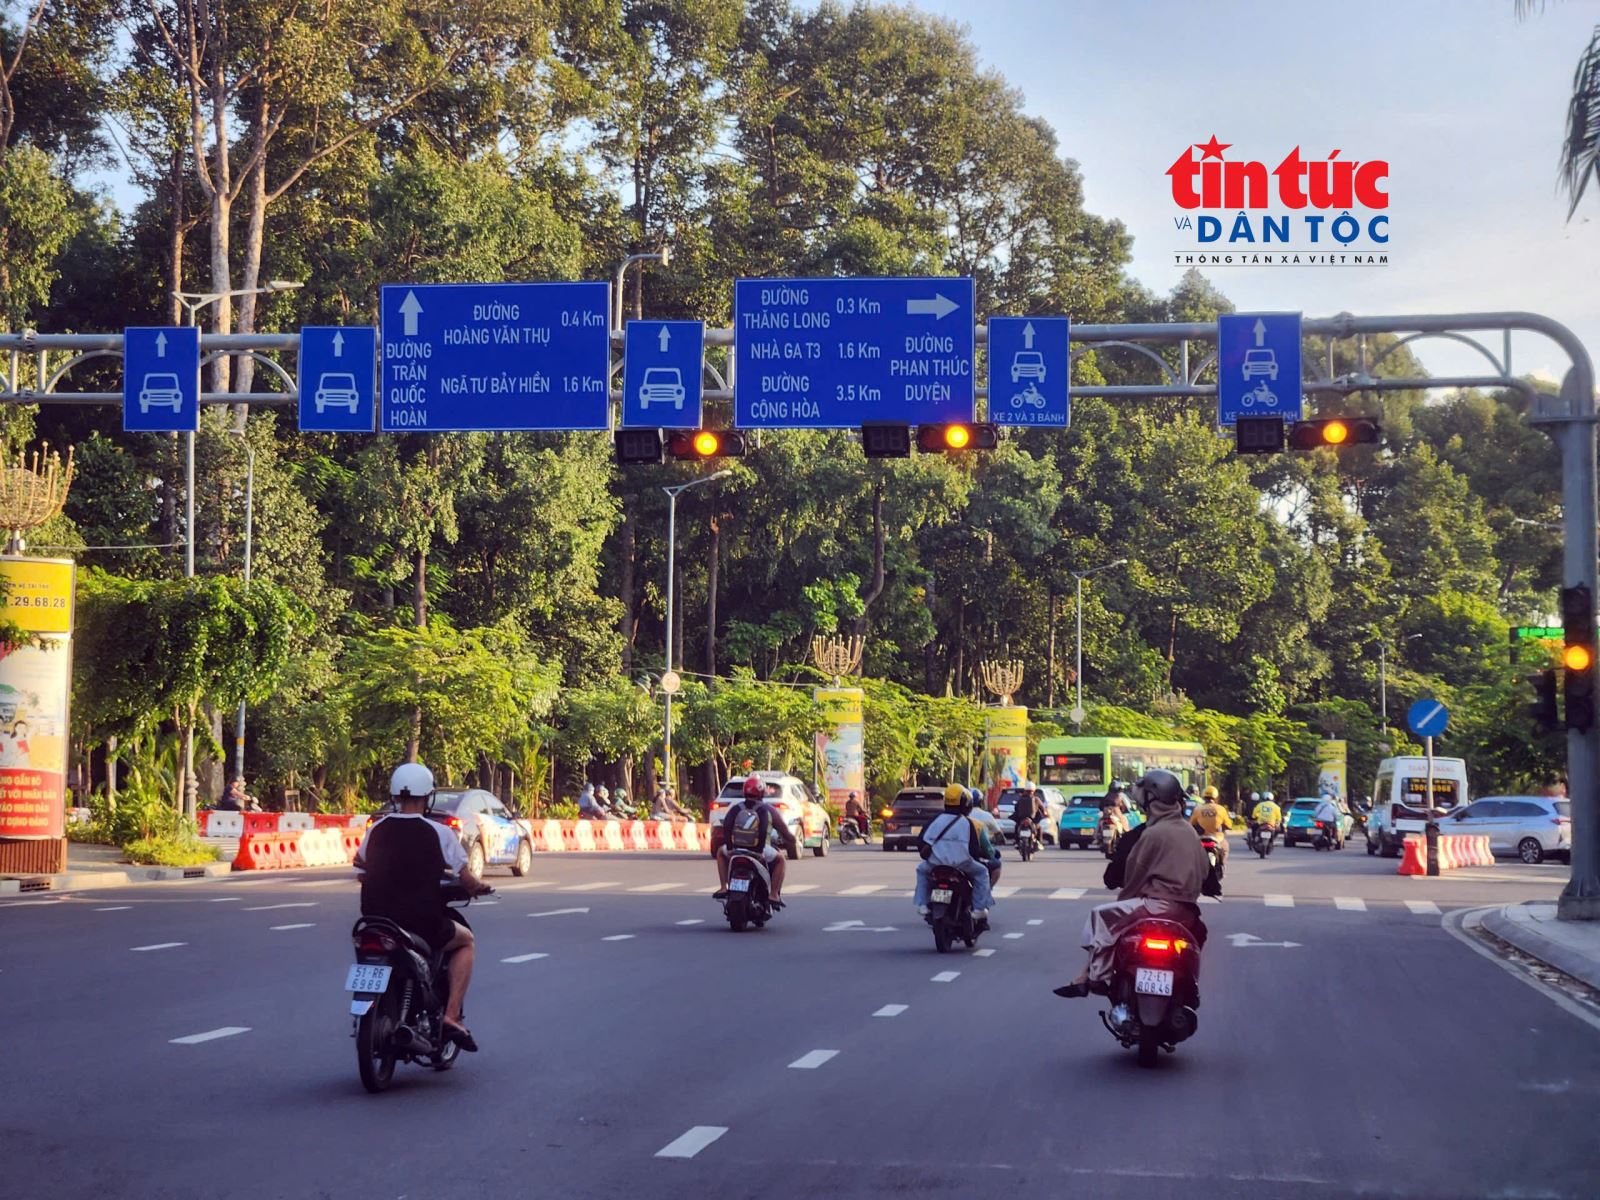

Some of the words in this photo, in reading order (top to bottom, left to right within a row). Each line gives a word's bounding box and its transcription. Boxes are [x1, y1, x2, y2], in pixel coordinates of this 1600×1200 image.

[761, 285, 808, 305] ĐƯỜNG
[474, 300, 519, 320] ĐƯỜNG
[837, 298, 854, 313] 0.3
[859, 298, 880, 313] Km
[562, 311, 579, 326] 0.4
[583, 311, 604, 326] Km
[743, 310, 789, 328] THĂNG
[794, 312, 830, 328] LONG
[444, 325, 489, 345] HOÀNG
[493, 325, 519, 344] VĂN
[523, 328, 550, 346] THỤ
[905, 332, 953, 353] ĐƯỜNG
[386, 339, 431, 358] ĐƯỜNG
[751, 339, 780, 359] NHÀ
[784, 343, 802, 358] GA
[806, 343, 820, 358] T3
[838, 342, 854, 358] 1.6
[859, 343, 880, 358] Km
[891, 360, 928, 376] PHAN
[933, 356, 969, 375] THÚC
[441, 375, 468, 393] NGÃ
[470, 376, 487, 393] TƯ
[491, 372, 516, 393] BẢY
[520, 371, 549, 392] HIỀN
[563, 377, 578, 392] 1.6
[583, 376, 603, 392] Km
[762, 371, 809, 392] ĐƯỜNG
[391, 382, 425, 403] QUỐC
[837, 385, 855, 400] 3.5
[859, 385, 880, 400] Km
[905, 381, 950, 404] DUYỆN
[391, 406, 426, 426] HOÀN
[751, 401, 787, 421] CỘNG
[792, 397, 820, 418] HÒA
[993, 412, 1005, 422] XE
[1007, 412, 1013, 422] 2
[1030, 412, 1035, 422] 3
[1037, 411, 1065, 422] BÁNH
